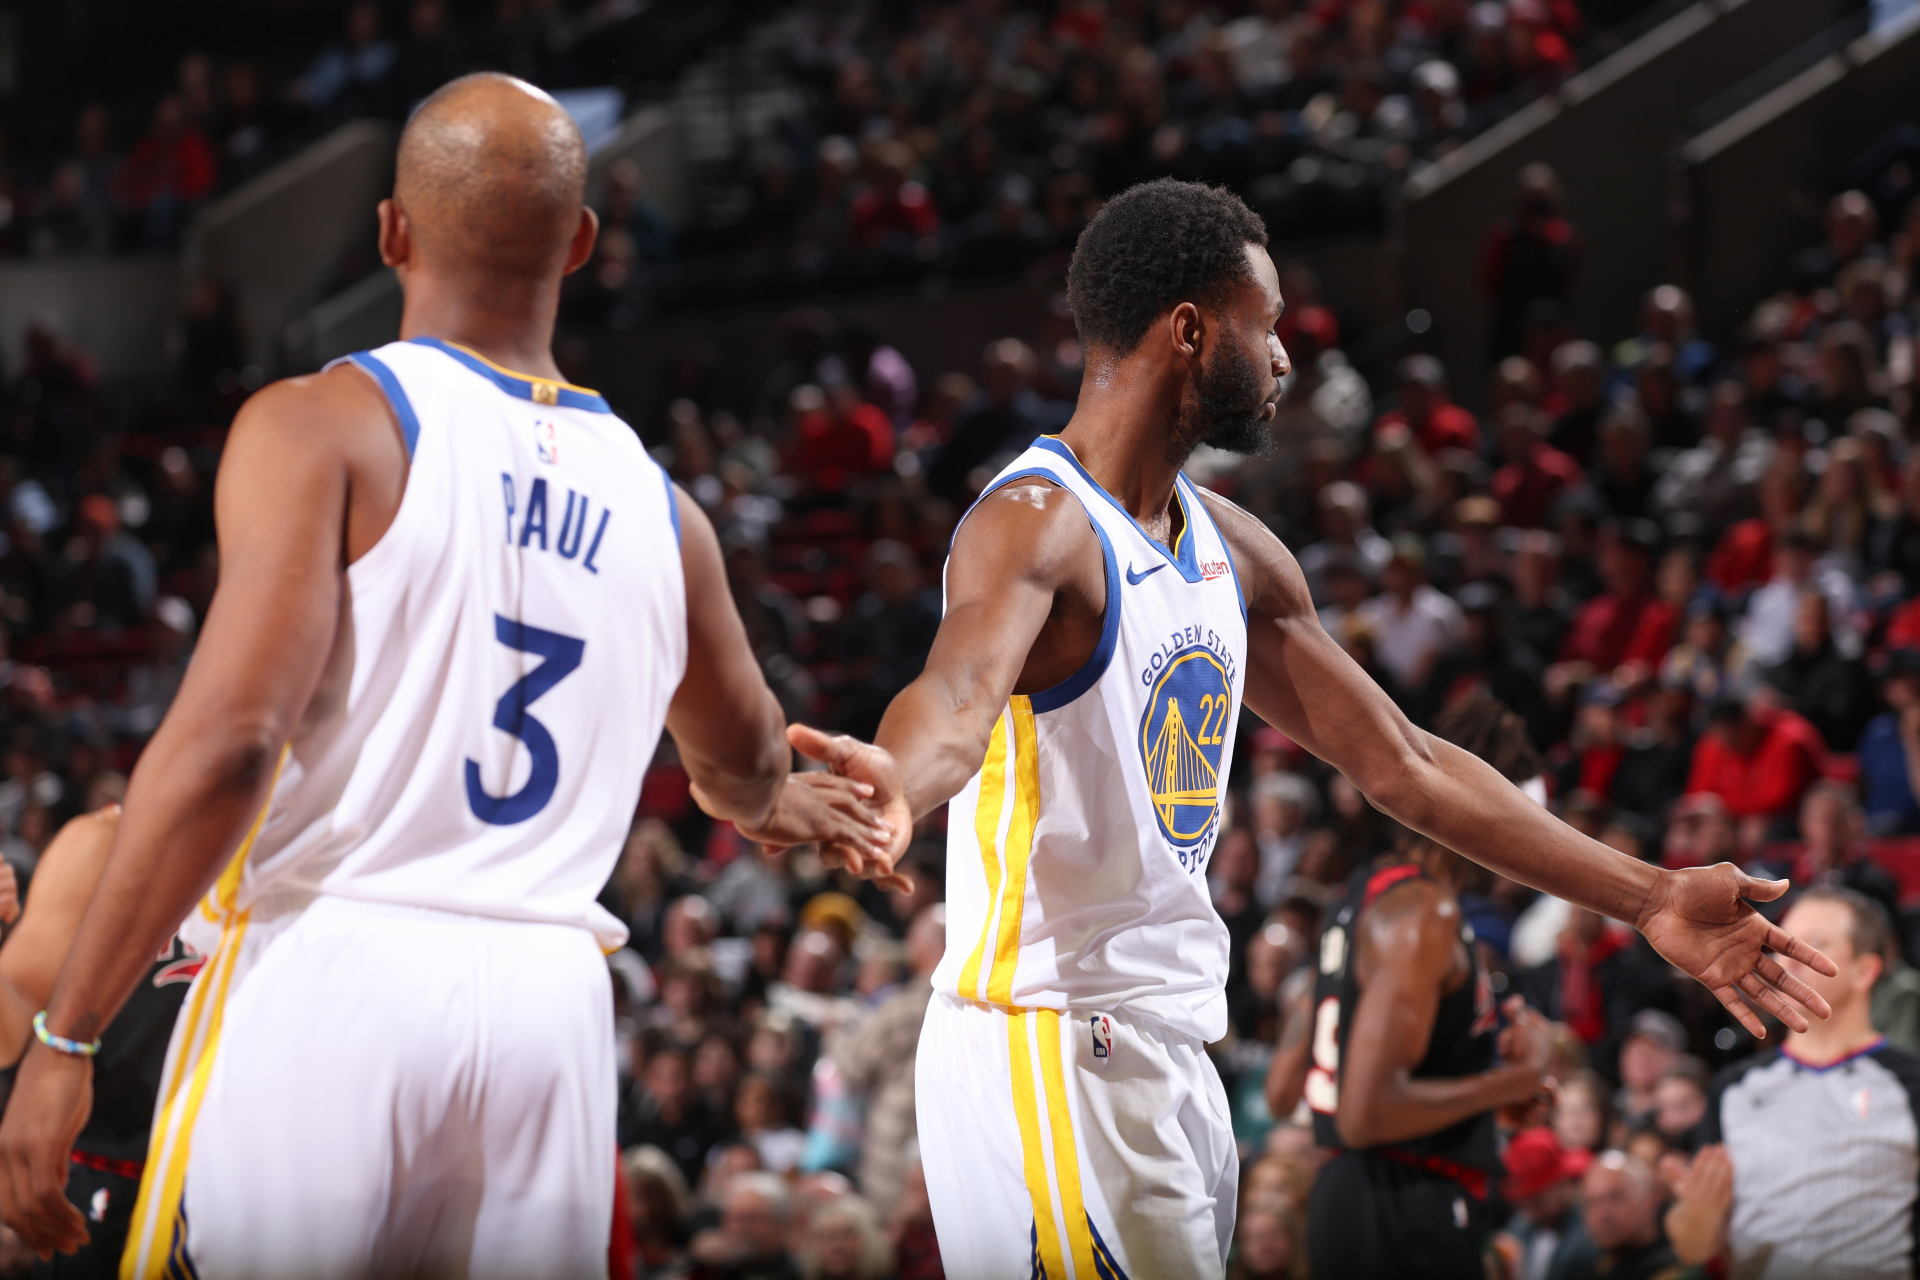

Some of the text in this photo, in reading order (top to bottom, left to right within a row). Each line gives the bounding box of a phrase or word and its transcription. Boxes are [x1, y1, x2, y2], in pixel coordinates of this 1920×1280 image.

[501, 472, 611, 575] PAUL
[1142, 624, 1236, 687] GOLDEN STATE
[465, 611, 586, 826] 3
[1197, 693, 1227, 746] 22
